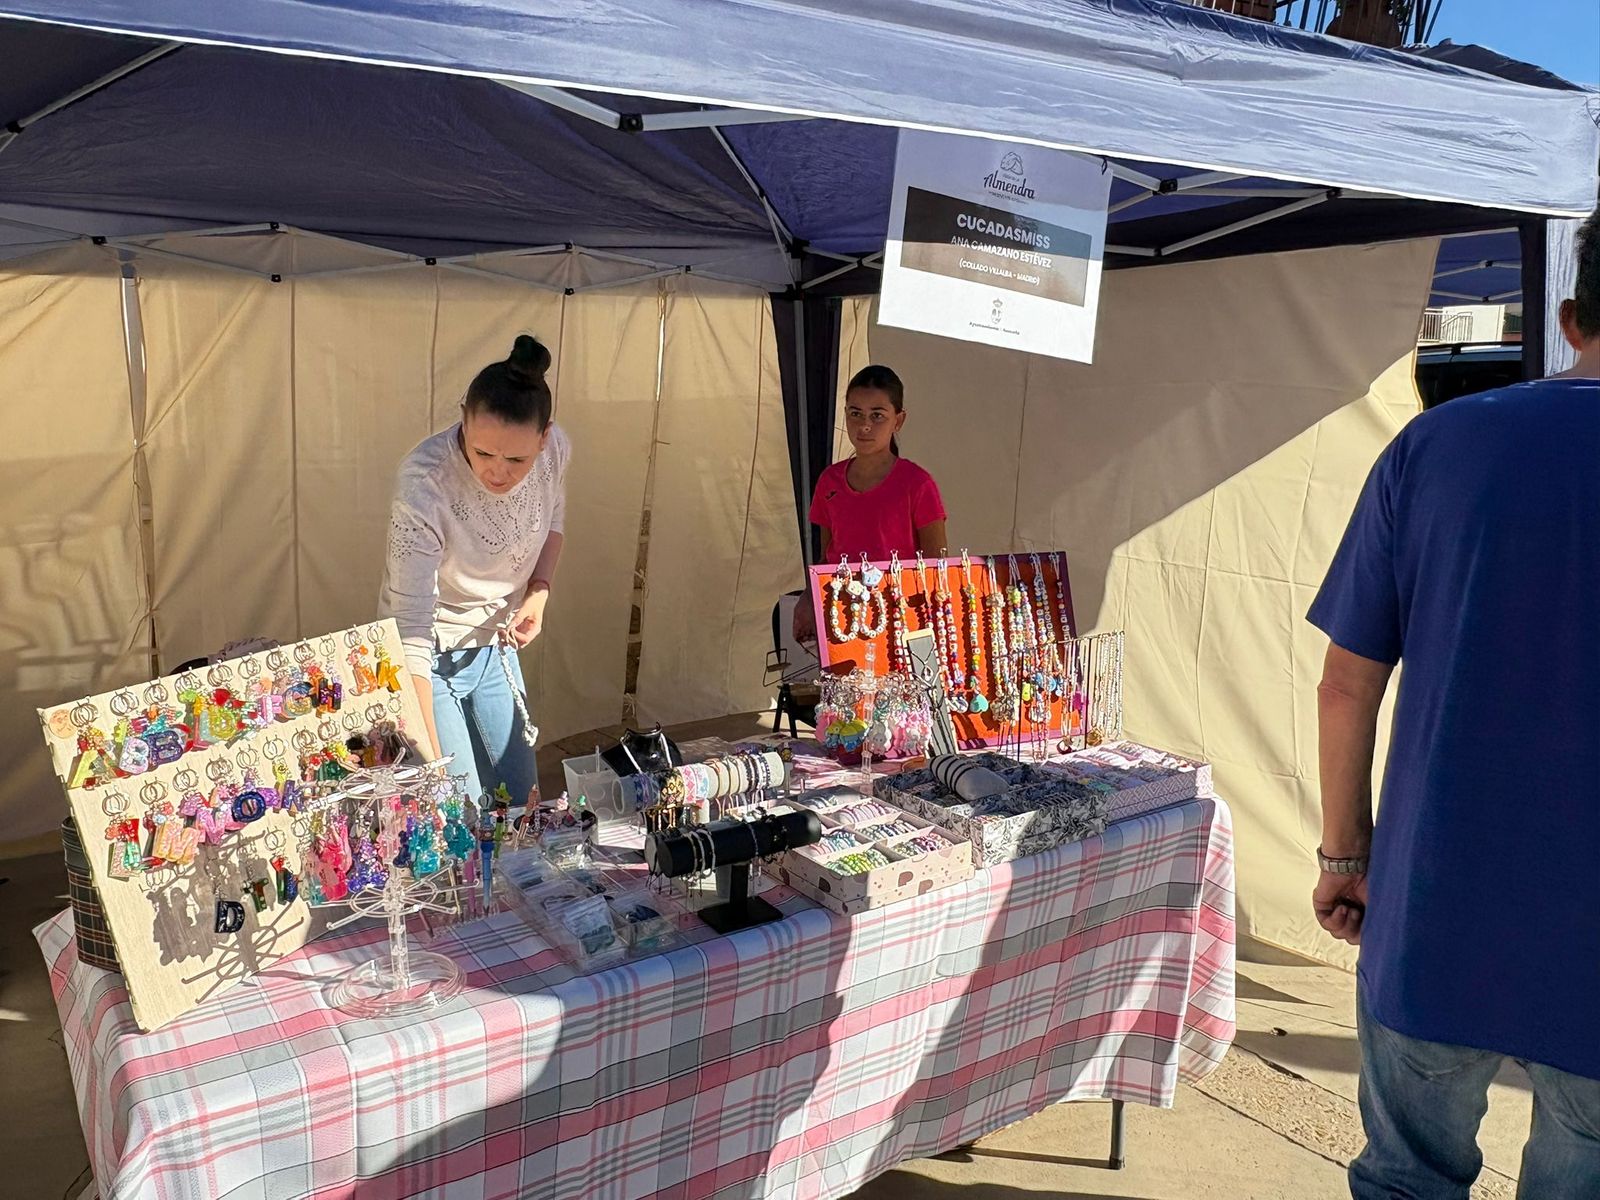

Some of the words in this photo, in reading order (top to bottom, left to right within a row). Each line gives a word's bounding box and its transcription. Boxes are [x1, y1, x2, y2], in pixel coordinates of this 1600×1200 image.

[984, 170, 1035, 199] Almendra
[957, 213, 1050, 249] CUCADASMISS
[950, 235, 971, 248] ANA
[971, 240, 1019, 260] CAMAZANO
[1020, 250, 1052, 268] ESTÉVEZ
[215, 900, 245, 933] D
